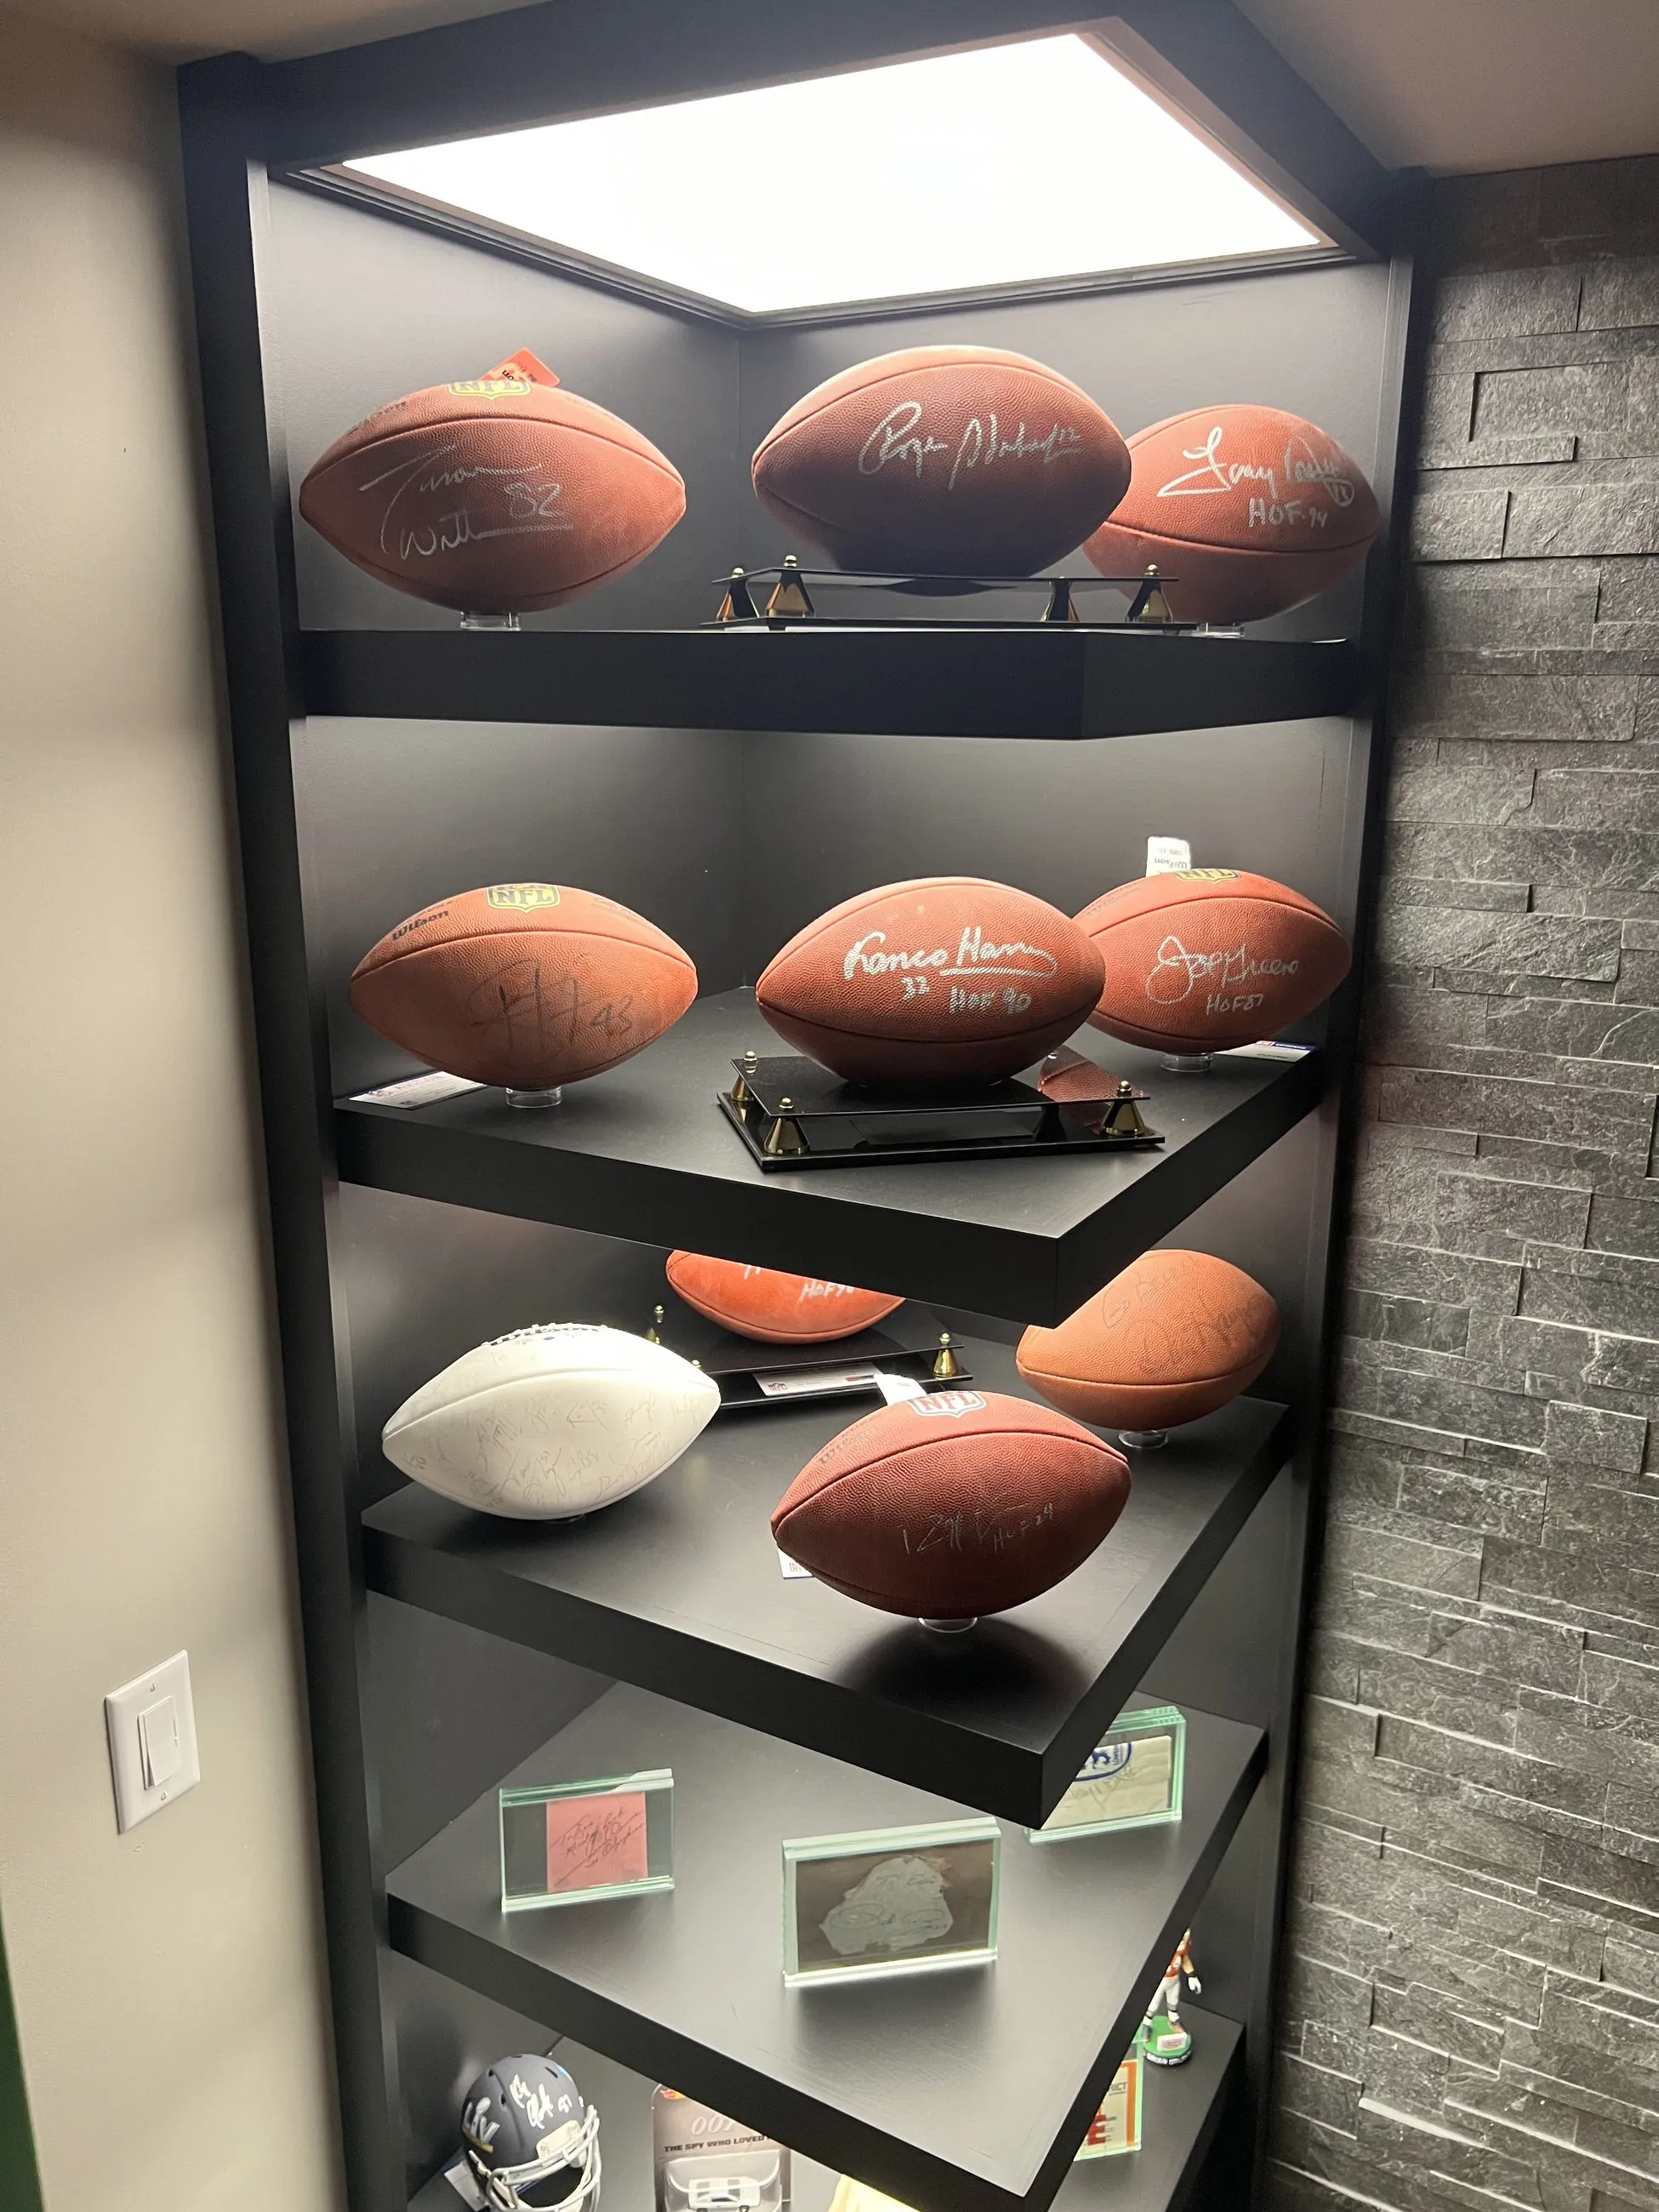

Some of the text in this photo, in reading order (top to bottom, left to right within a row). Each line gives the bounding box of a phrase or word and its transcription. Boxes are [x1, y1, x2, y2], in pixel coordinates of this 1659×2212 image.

[1154, 858, 1189, 869] Wilson
[496, 888, 552, 905] NFL
[391, 910, 449, 940] Wilson
[917, 1391, 978, 1412] NFL
[664, 2144, 683, 2152] THE
[685, 2142, 704, 2151] SPY
[733, 2135, 766, 2144] LOVED
